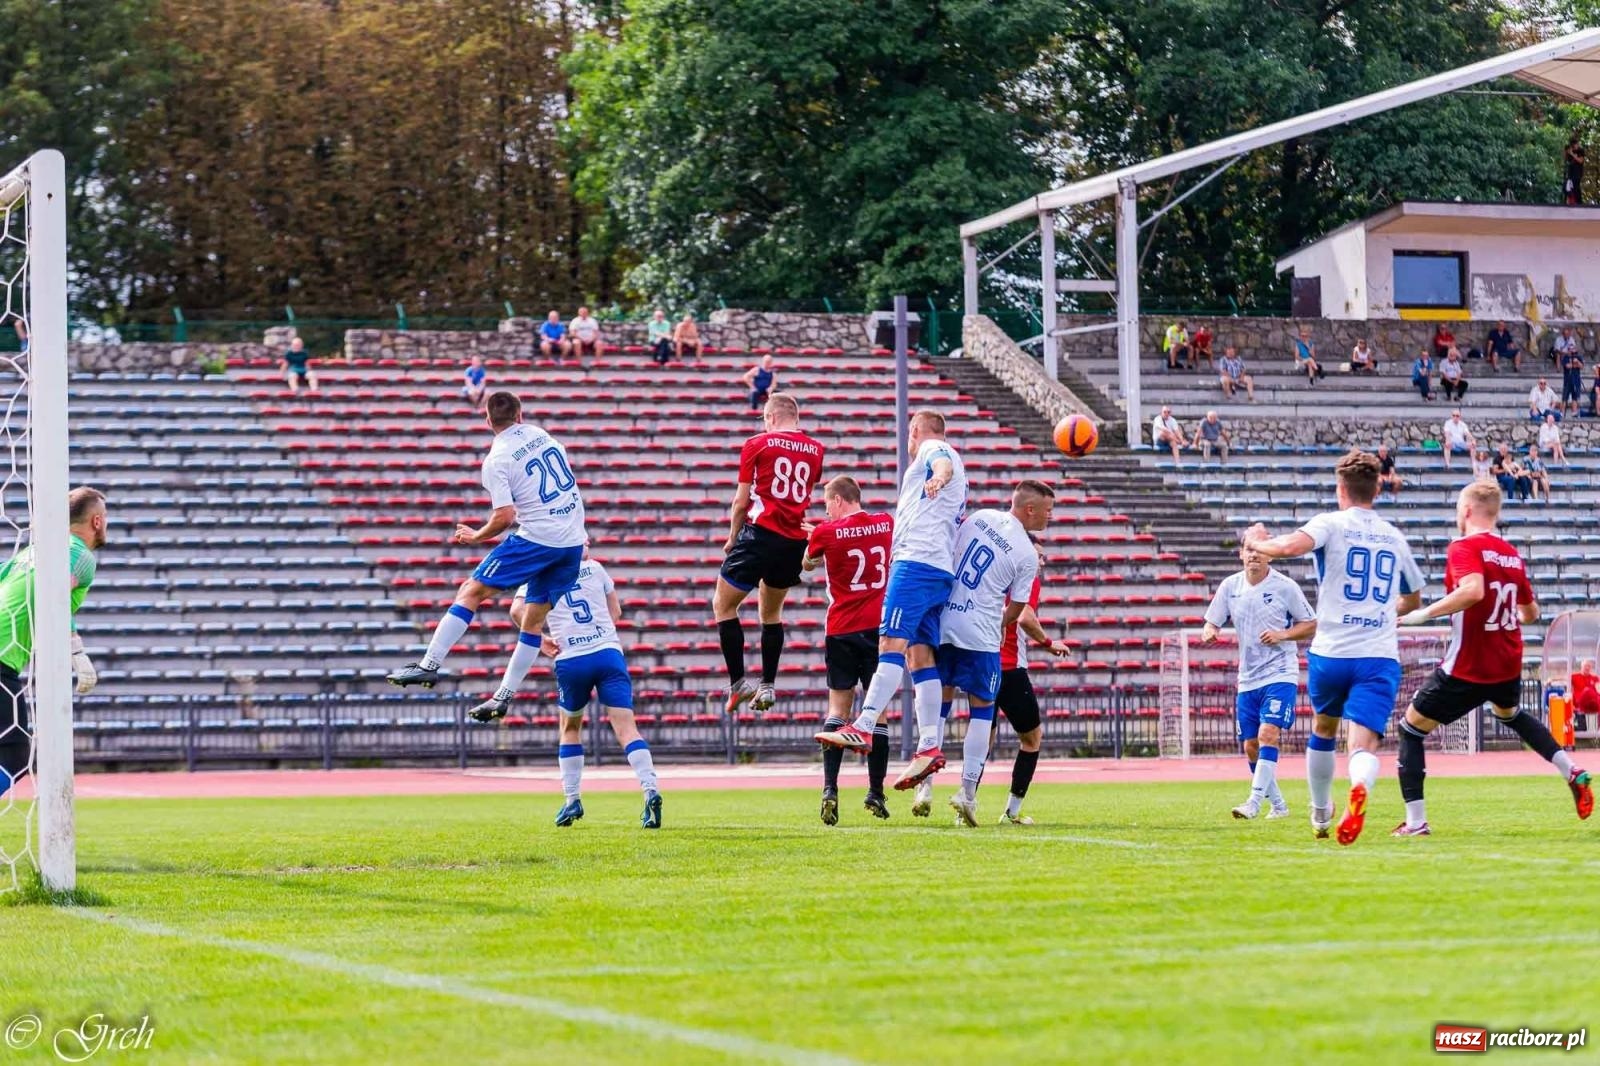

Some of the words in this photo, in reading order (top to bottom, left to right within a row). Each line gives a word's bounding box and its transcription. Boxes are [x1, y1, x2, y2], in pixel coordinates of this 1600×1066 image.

[767, 437, 819, 456] DRZEWIARZ
[525, 446, 576, 504] 20
[770, 456, 811, 503] 88
[835, 522, 891, 539] DRZEWIARZ
[847, 545, 887, 592] 23
[955, 537, 995, 591] 19
[1343, 546, 1396, 604] 99
[565, 583, 593, 624] 5
